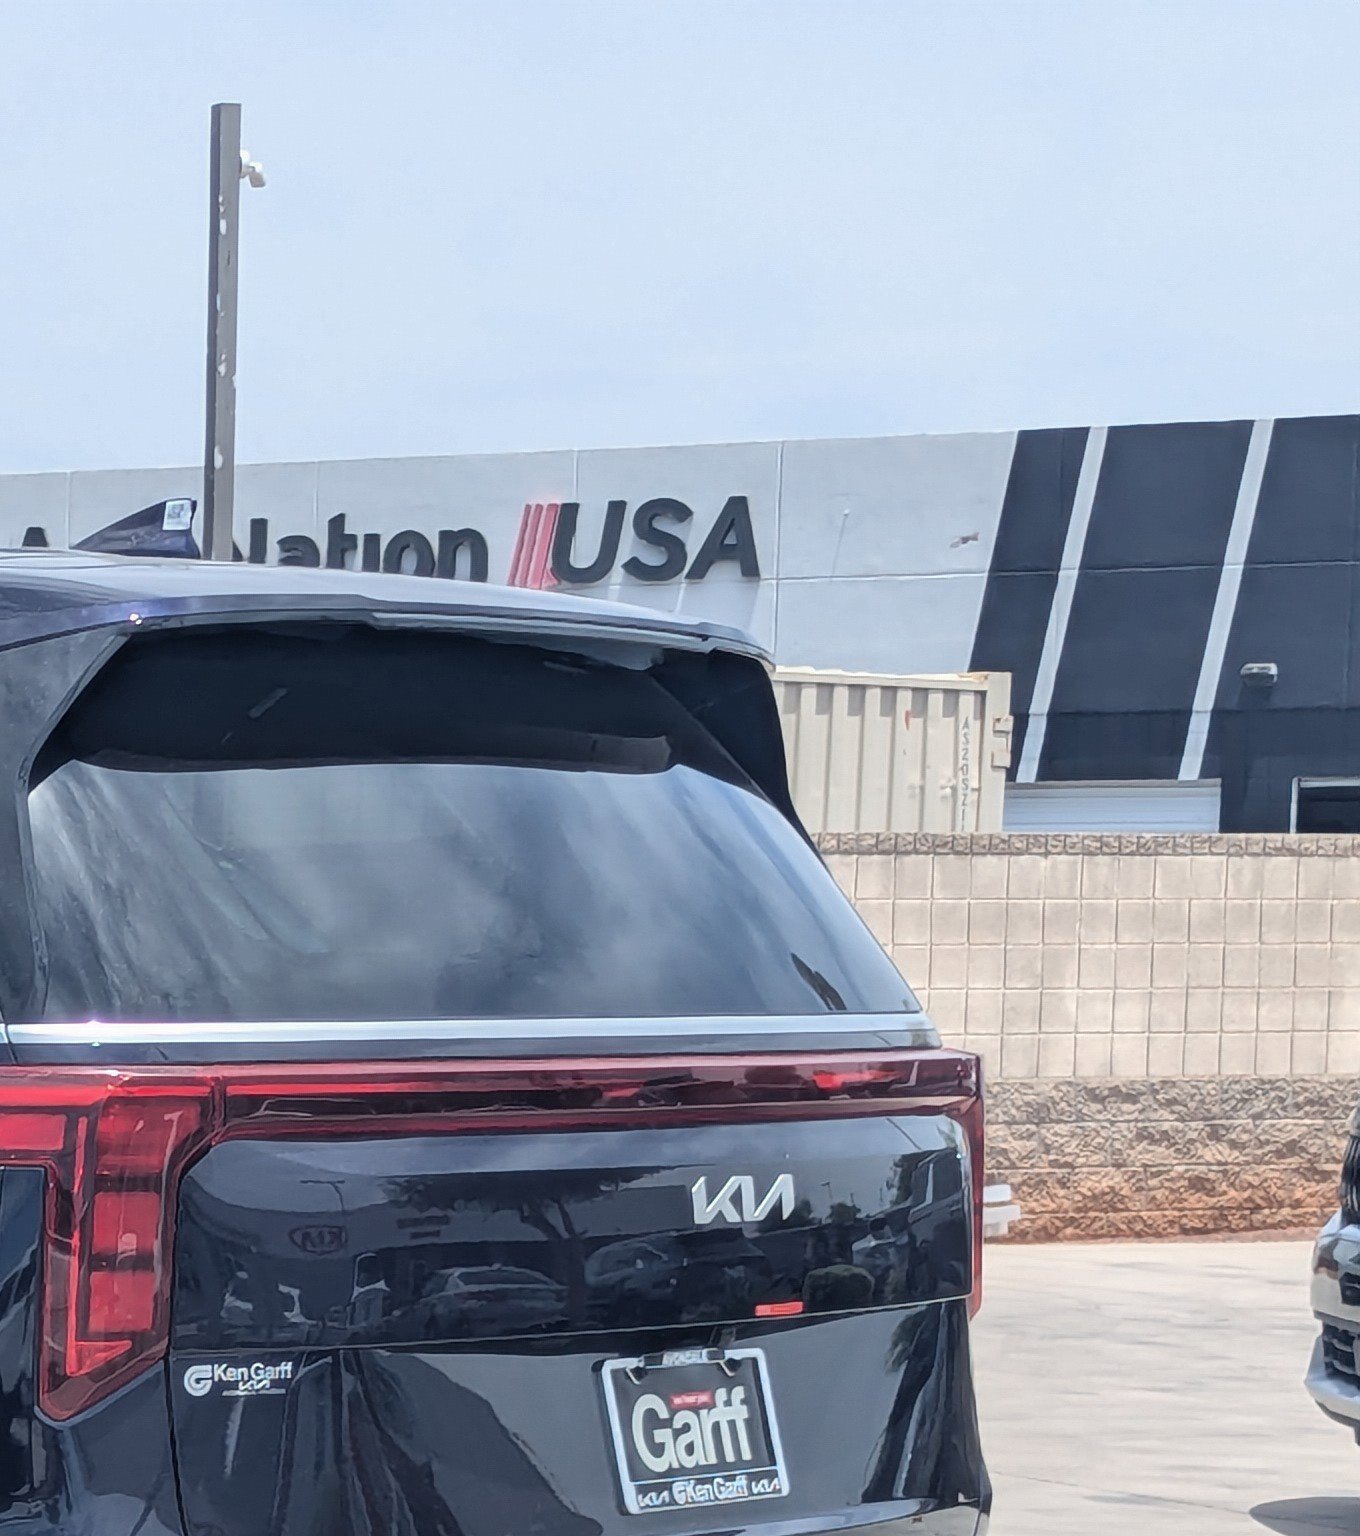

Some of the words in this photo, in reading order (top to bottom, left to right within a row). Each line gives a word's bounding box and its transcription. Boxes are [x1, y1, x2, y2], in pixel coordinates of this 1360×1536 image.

[551, 496, 760, 585] USA
[691, 1173, 795, 1224] KIA
[214, 1363, 249, 1382] Ken
[250, 1361, 293, 1381] Garff
[632, 1386, 752, 1473] Garff
